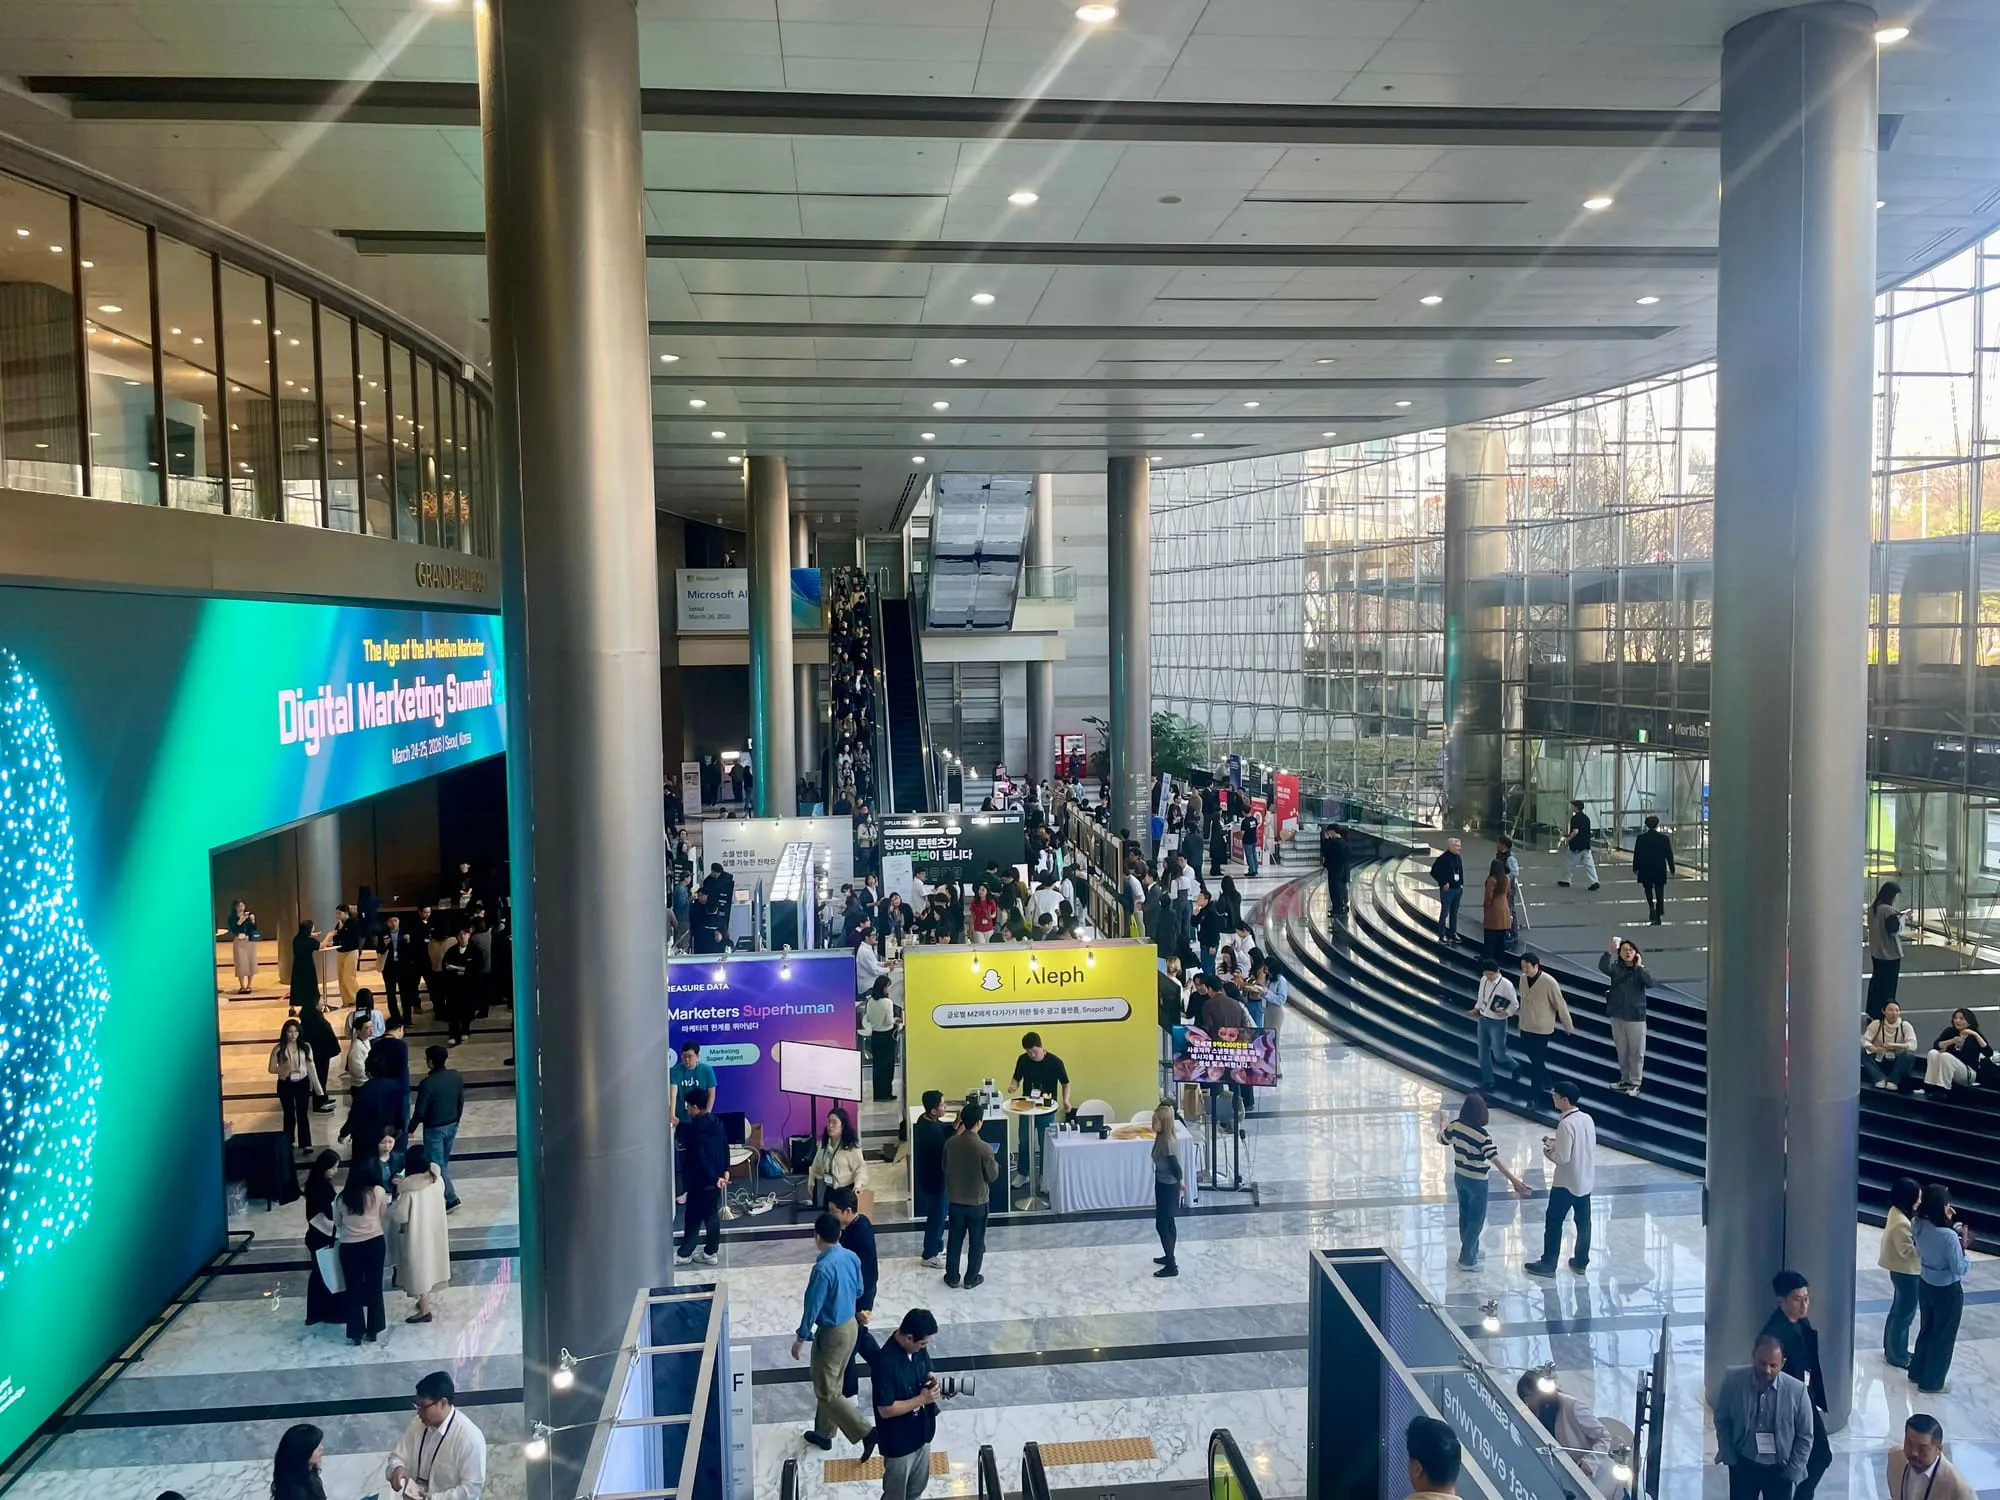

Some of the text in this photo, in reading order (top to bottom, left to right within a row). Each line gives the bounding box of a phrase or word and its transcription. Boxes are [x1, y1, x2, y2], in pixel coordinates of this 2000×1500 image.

[415, 561, 453, 590] GRAND
[687, 589, 748, 599] Microsoft AI
[363, 638, 381, 662] The
[383, 638, 400, 668] Age
[401, 638, 410, 660] of
[411, 638, 424, 660] the
[278, 682, 354, 757] Digital
[357, 678, 445, 728] Marketing
[446, 670, 493, 713] Summit
[391, 746, 411, 766] March
[428, 738, 443, 756] 2026
[884, 838, 958, 850] 당신의 콘텐츠가
[942, 849, 973, 861] 됩니다
[757, 857, 778, 867] 전략으
[1026, 965, 1084, 988] Aleph
[707, 983, 730, 991] DATA
[667, 1001, 835, 1020] Marketers Superhuman
[968, 1010, 991, 1018] MZ에게
[992, 1009, 1017, 1017] 다가가기
[1082, 1005, 1116, 1014] Snapchat
[709, 1048, 740, 1056] Marketing
[725, 1054, 744, 1062] Agent
